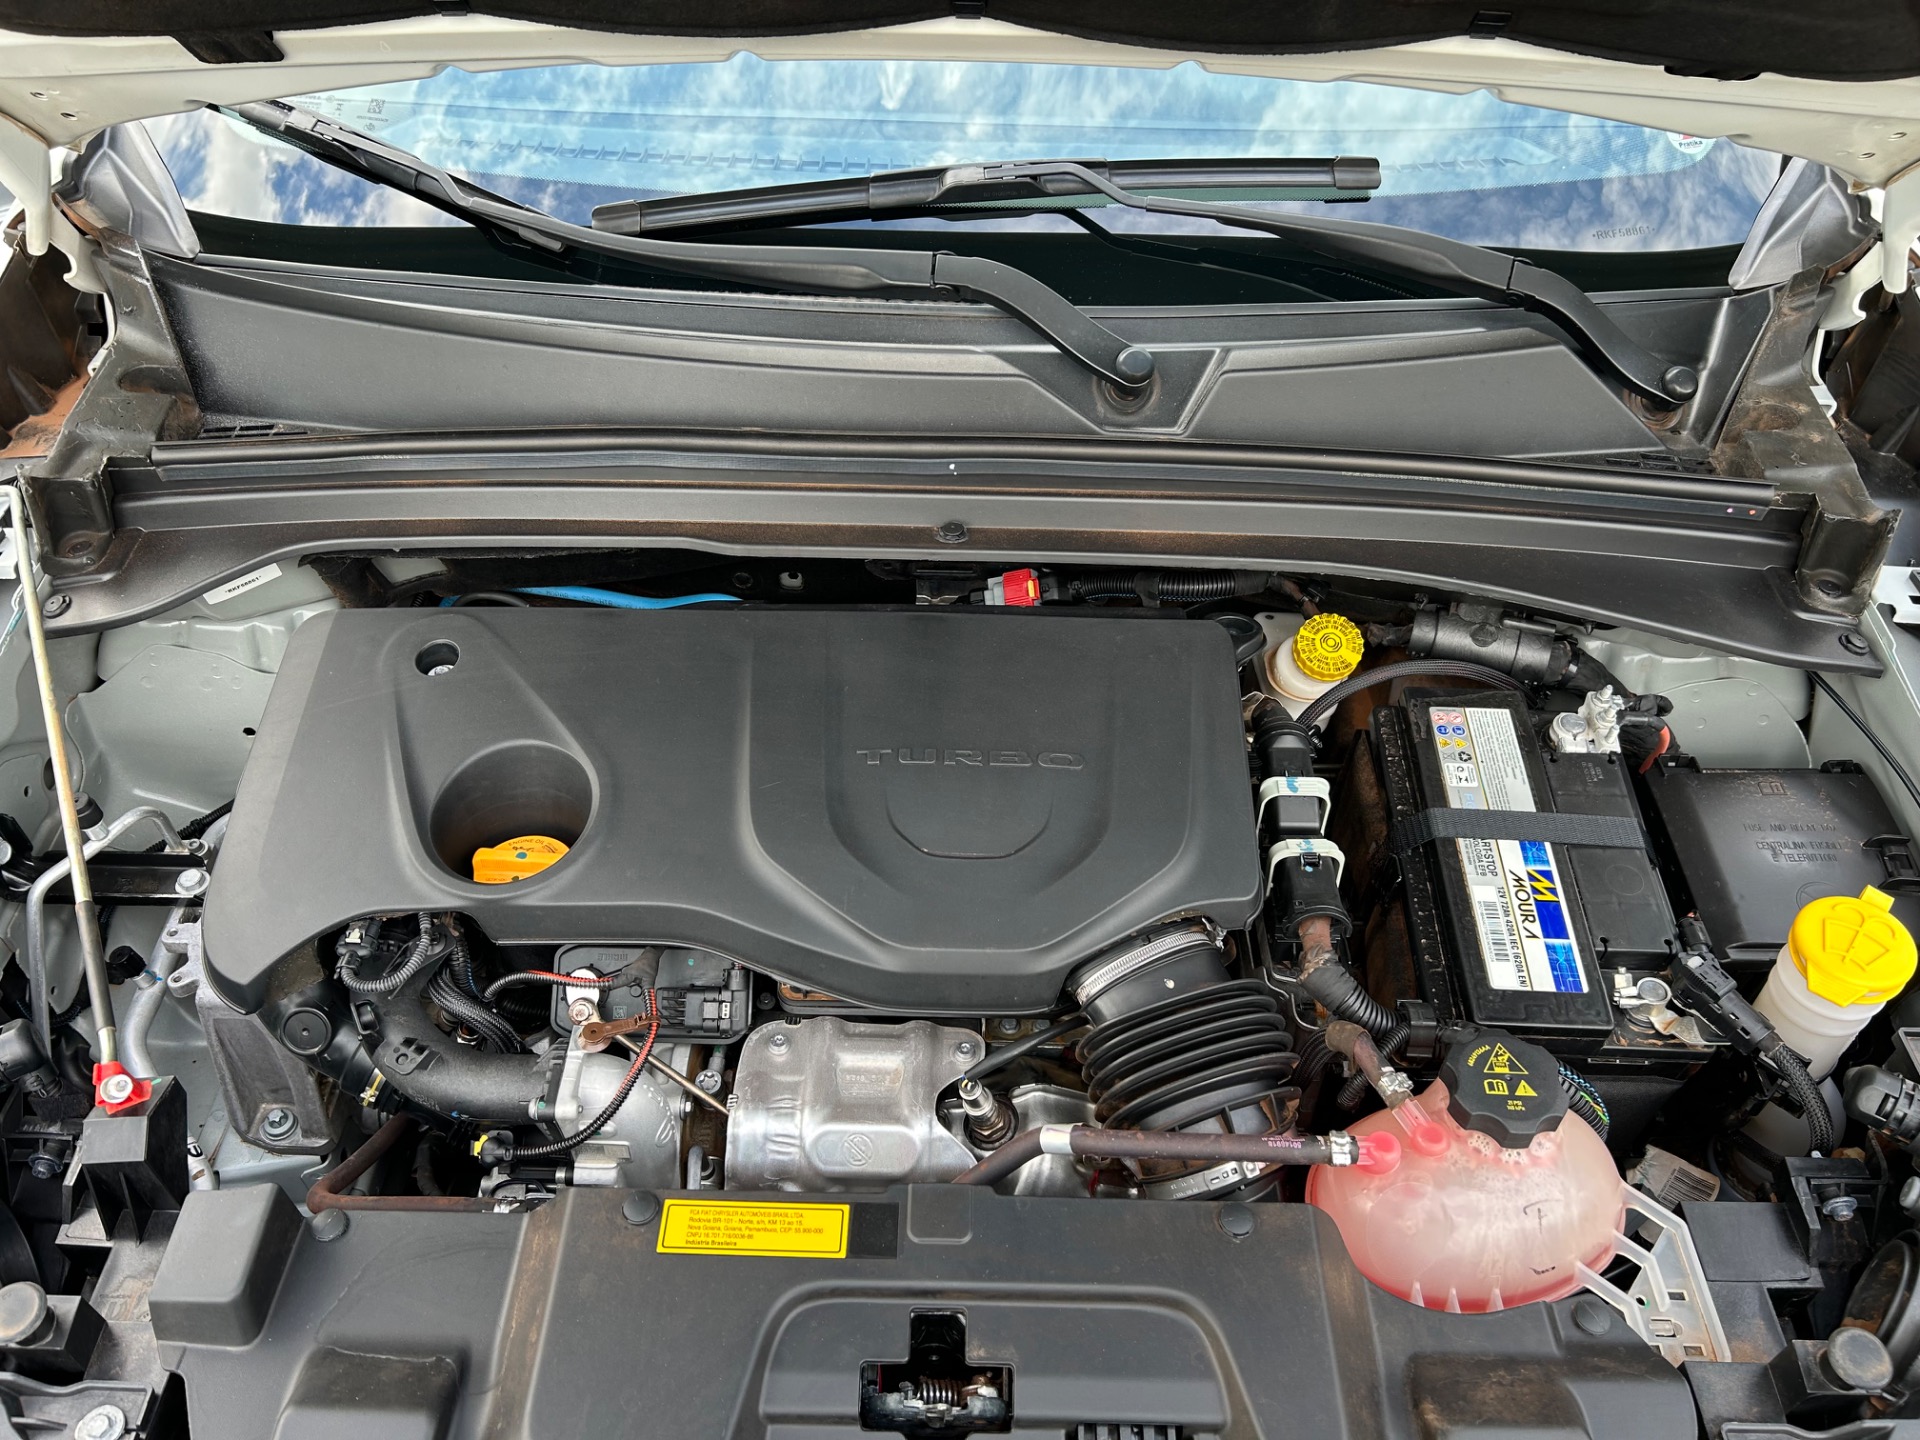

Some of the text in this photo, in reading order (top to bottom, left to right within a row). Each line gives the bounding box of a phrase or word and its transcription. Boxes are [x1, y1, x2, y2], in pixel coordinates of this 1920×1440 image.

[1679, 140, 1703, 149] Pratika
[856, 749, 1085, 769] TURBO
[1769, 823, 1786, 832] AND
[1756, 841, 1806, 850] CENTRALINA
[1509, 869, 1541, 939] MOURA
[1497, 886, 1529, 988] 12V 72Ah 420A IEC (620A EN)
